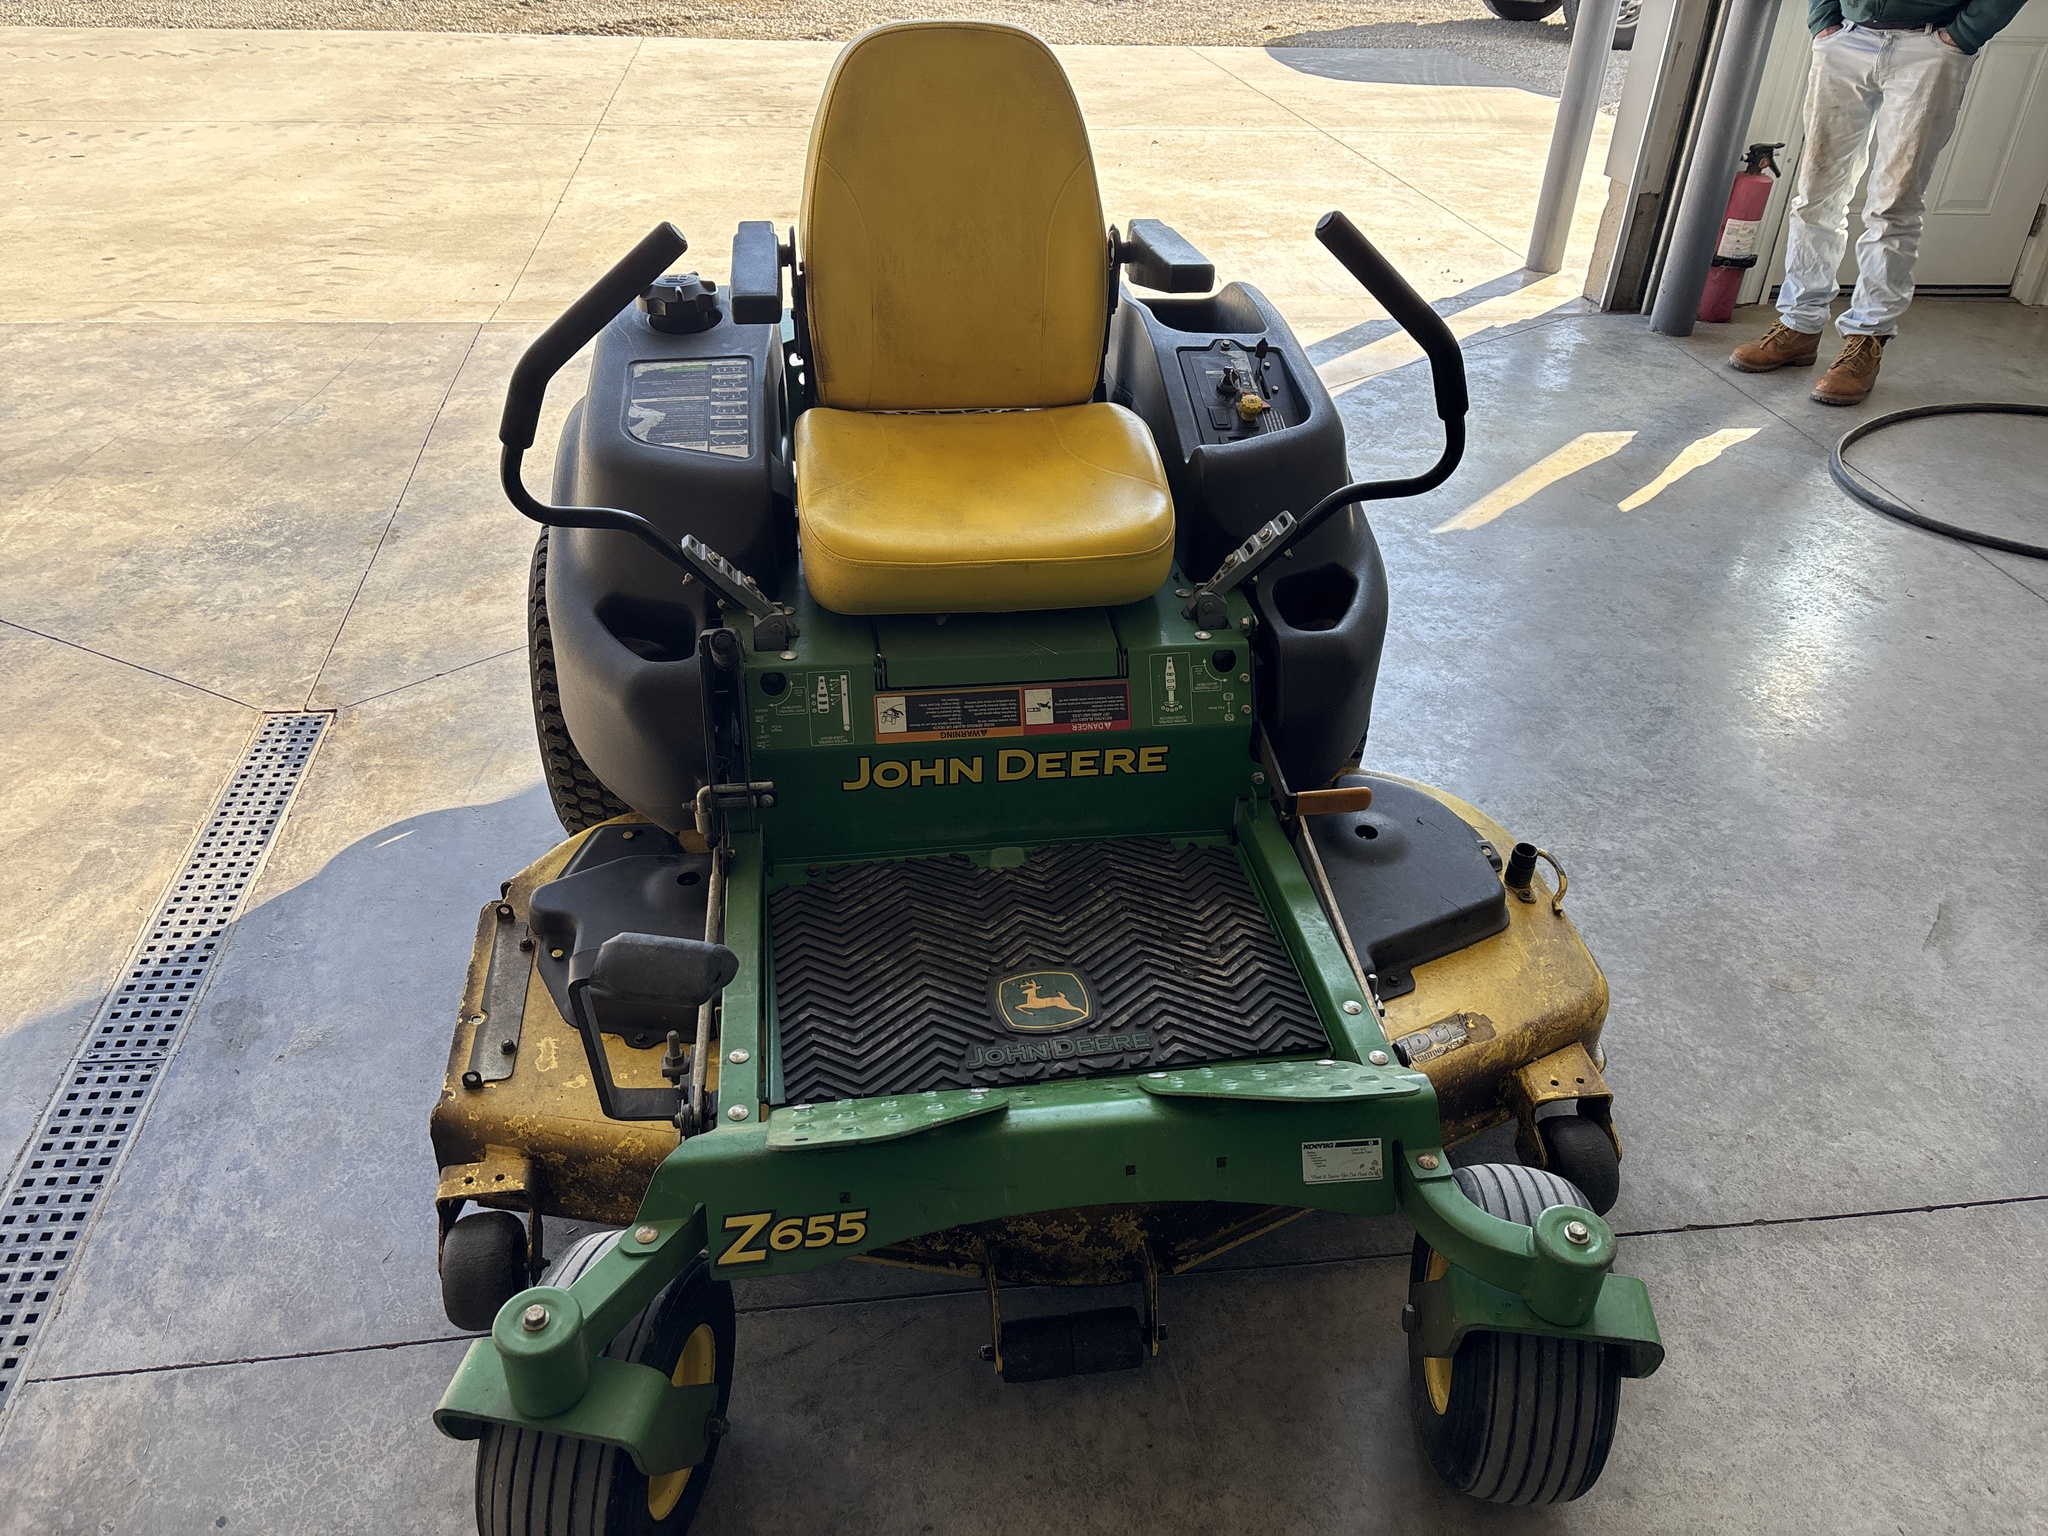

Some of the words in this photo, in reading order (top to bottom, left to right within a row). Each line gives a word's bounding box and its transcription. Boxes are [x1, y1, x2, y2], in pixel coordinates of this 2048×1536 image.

[939, 730, 981, 739] WARNING
[1070, 722, 1104, 731] DANGER
[842, 756, 983, 791] JOHN
[997, 745, 1169, 781] DEERE
[966, 1043, 1049, 1068] JOHN
[1051, 1033, 1151, 1057] DEERE
[717, 1210, 867, 1265] Z655
